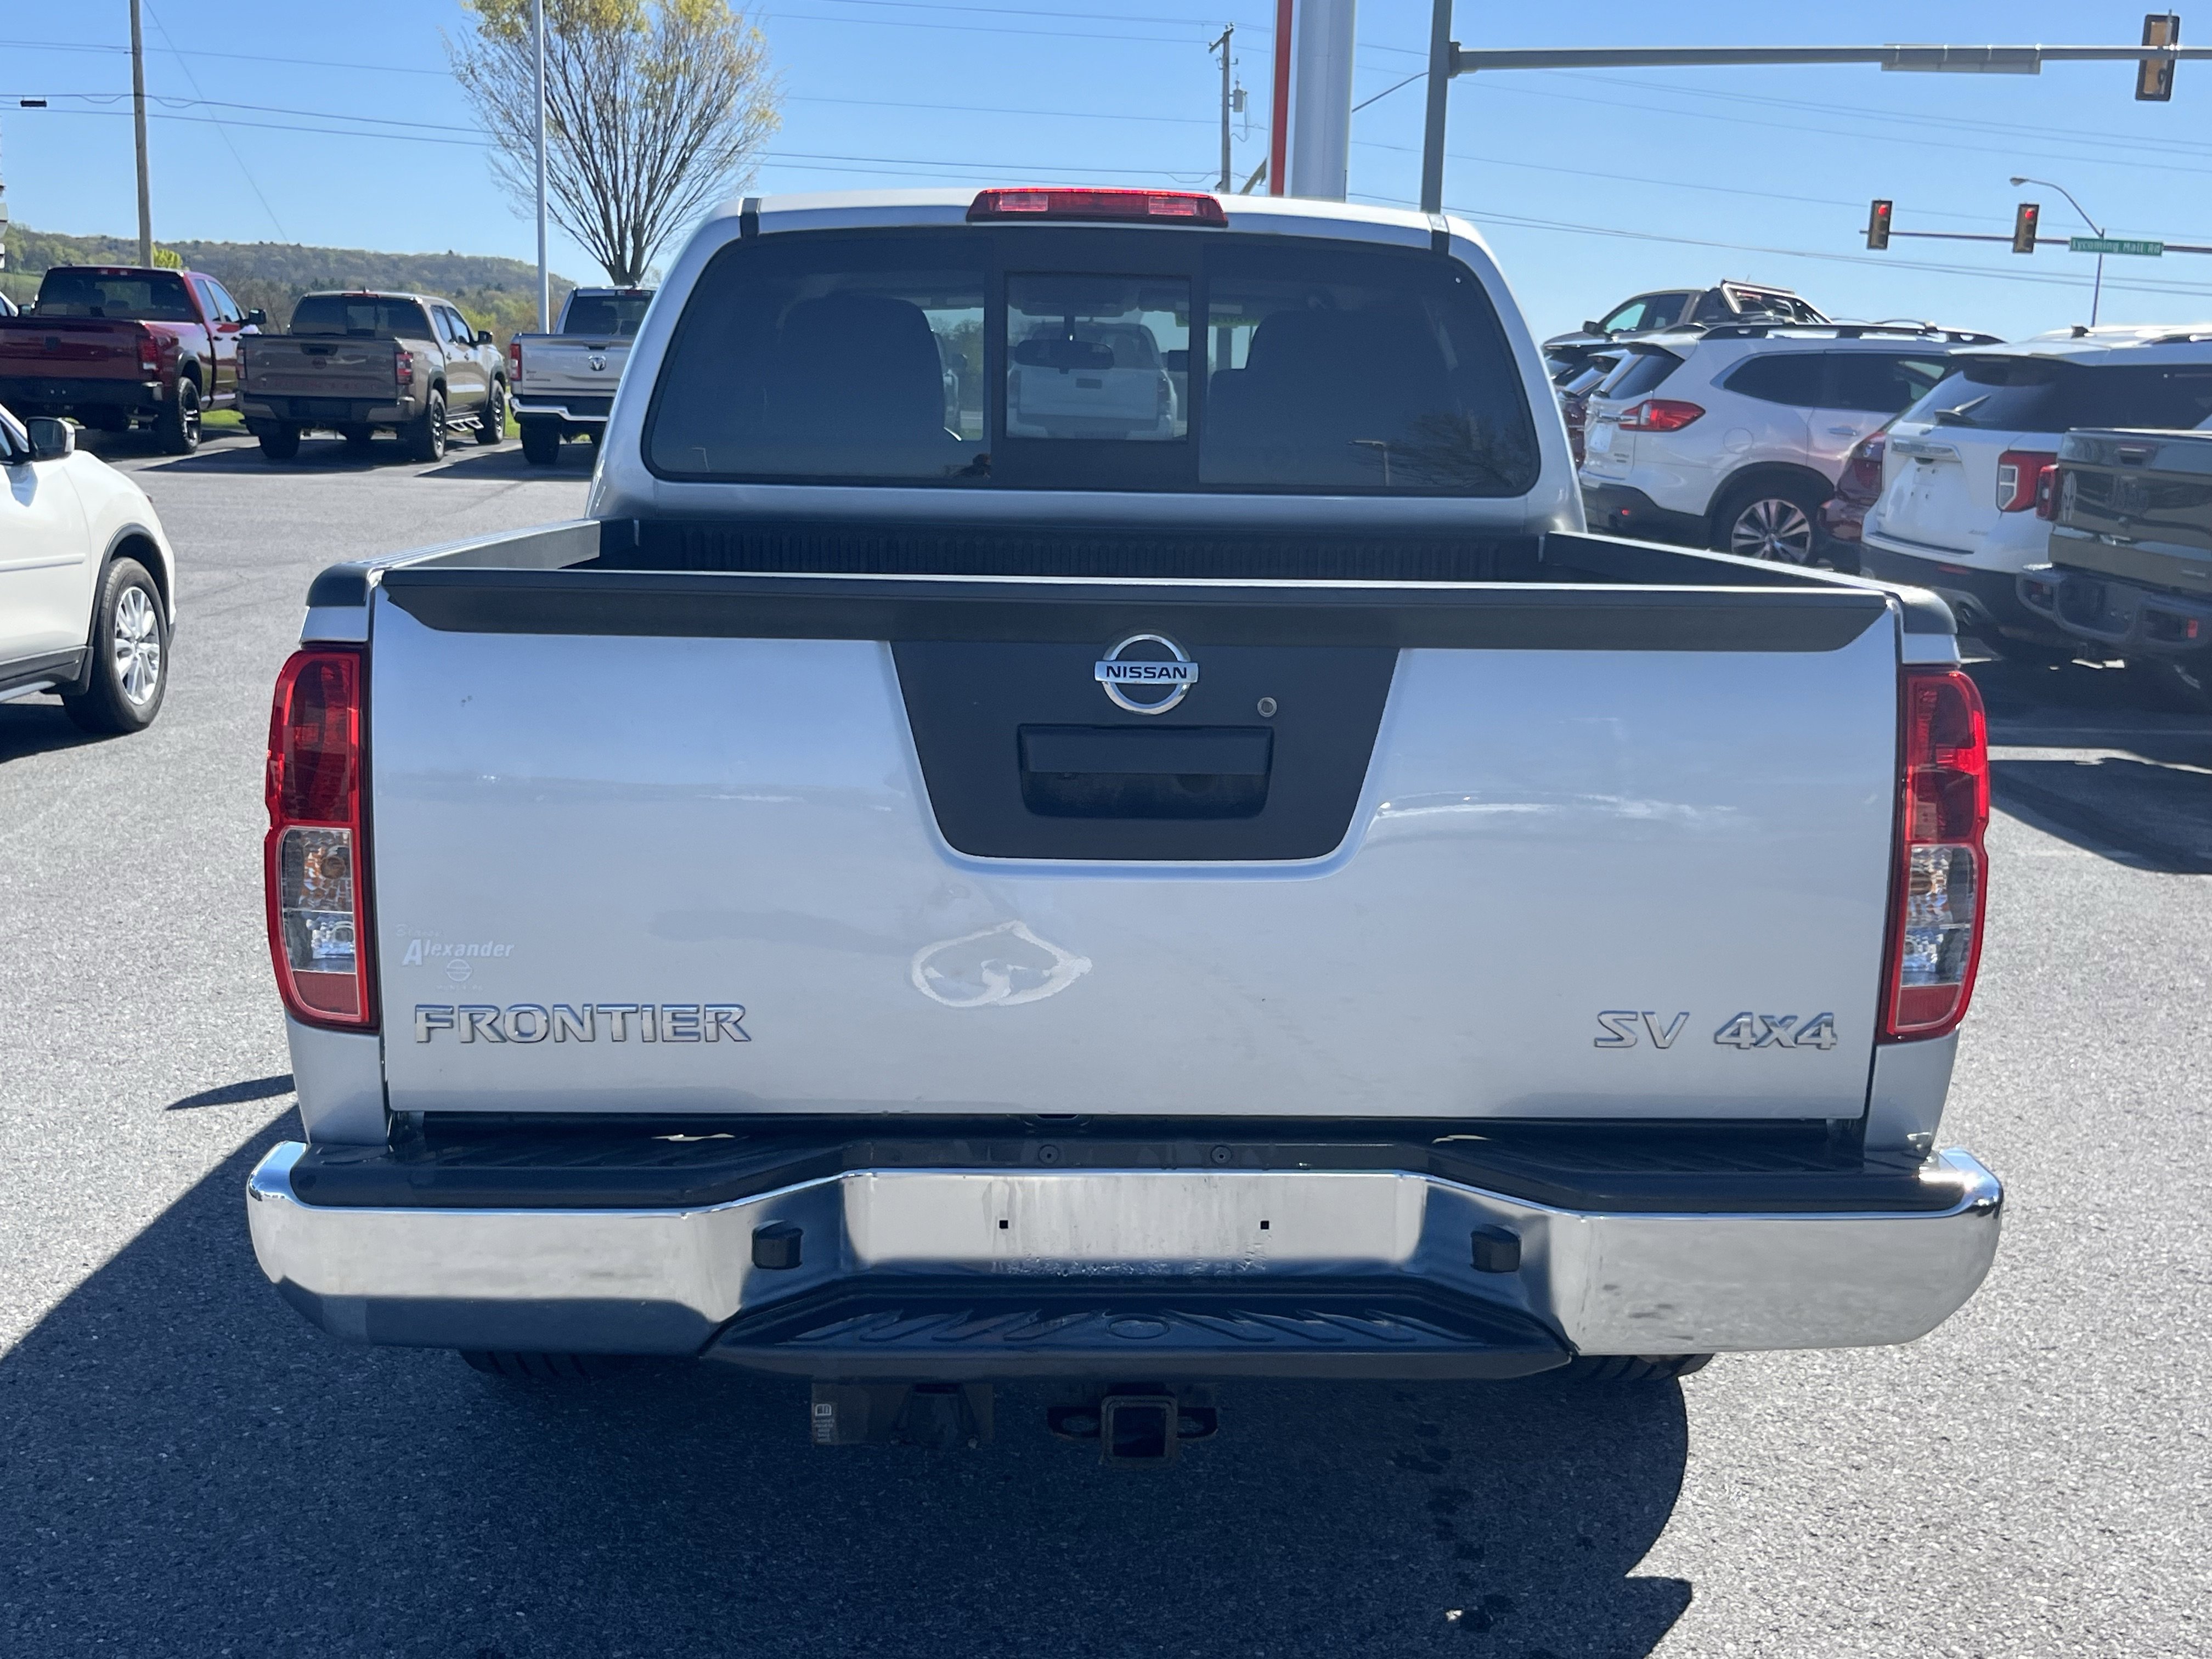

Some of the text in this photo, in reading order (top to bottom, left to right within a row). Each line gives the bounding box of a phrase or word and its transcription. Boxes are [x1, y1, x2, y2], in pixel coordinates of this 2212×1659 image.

[2072, 239, 2160, 254] Lycoming Mall Rd
[1106, 665, 1187, 679] NISSAN
[402, 939, 515, 967] Alexander
[415, 1004, 751, 1043] FRONTIER
[1594, 1010, 1690, 1049] SV
